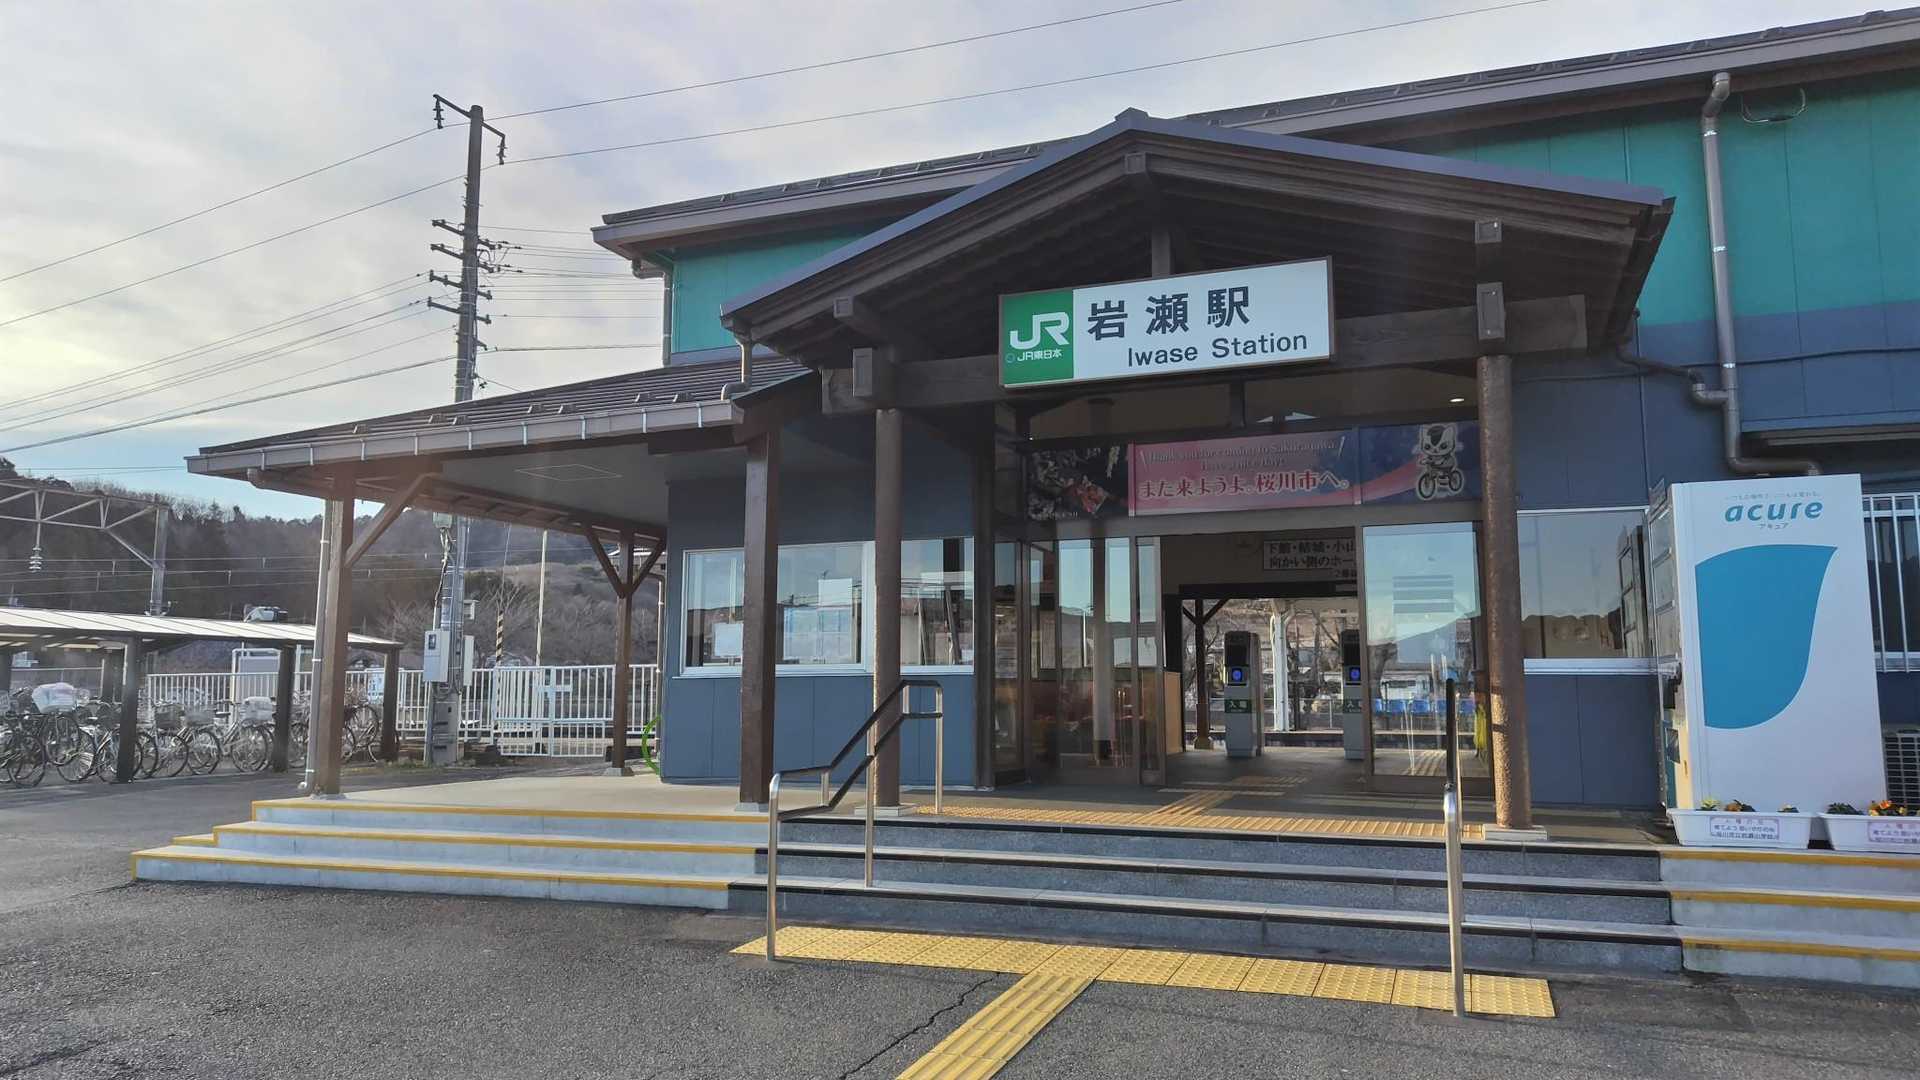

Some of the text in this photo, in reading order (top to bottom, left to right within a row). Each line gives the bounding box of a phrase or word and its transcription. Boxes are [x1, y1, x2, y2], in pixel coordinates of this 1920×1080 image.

[1009, 311, 1071, 350] JR
[1087, 286, 1250, 341] 岩瀬駅
[1017, 348, 1063, 362] JR東日本
[1128, 332, 1308, 367] Iwase Station
[1724, 501, 1823, 522] acure
